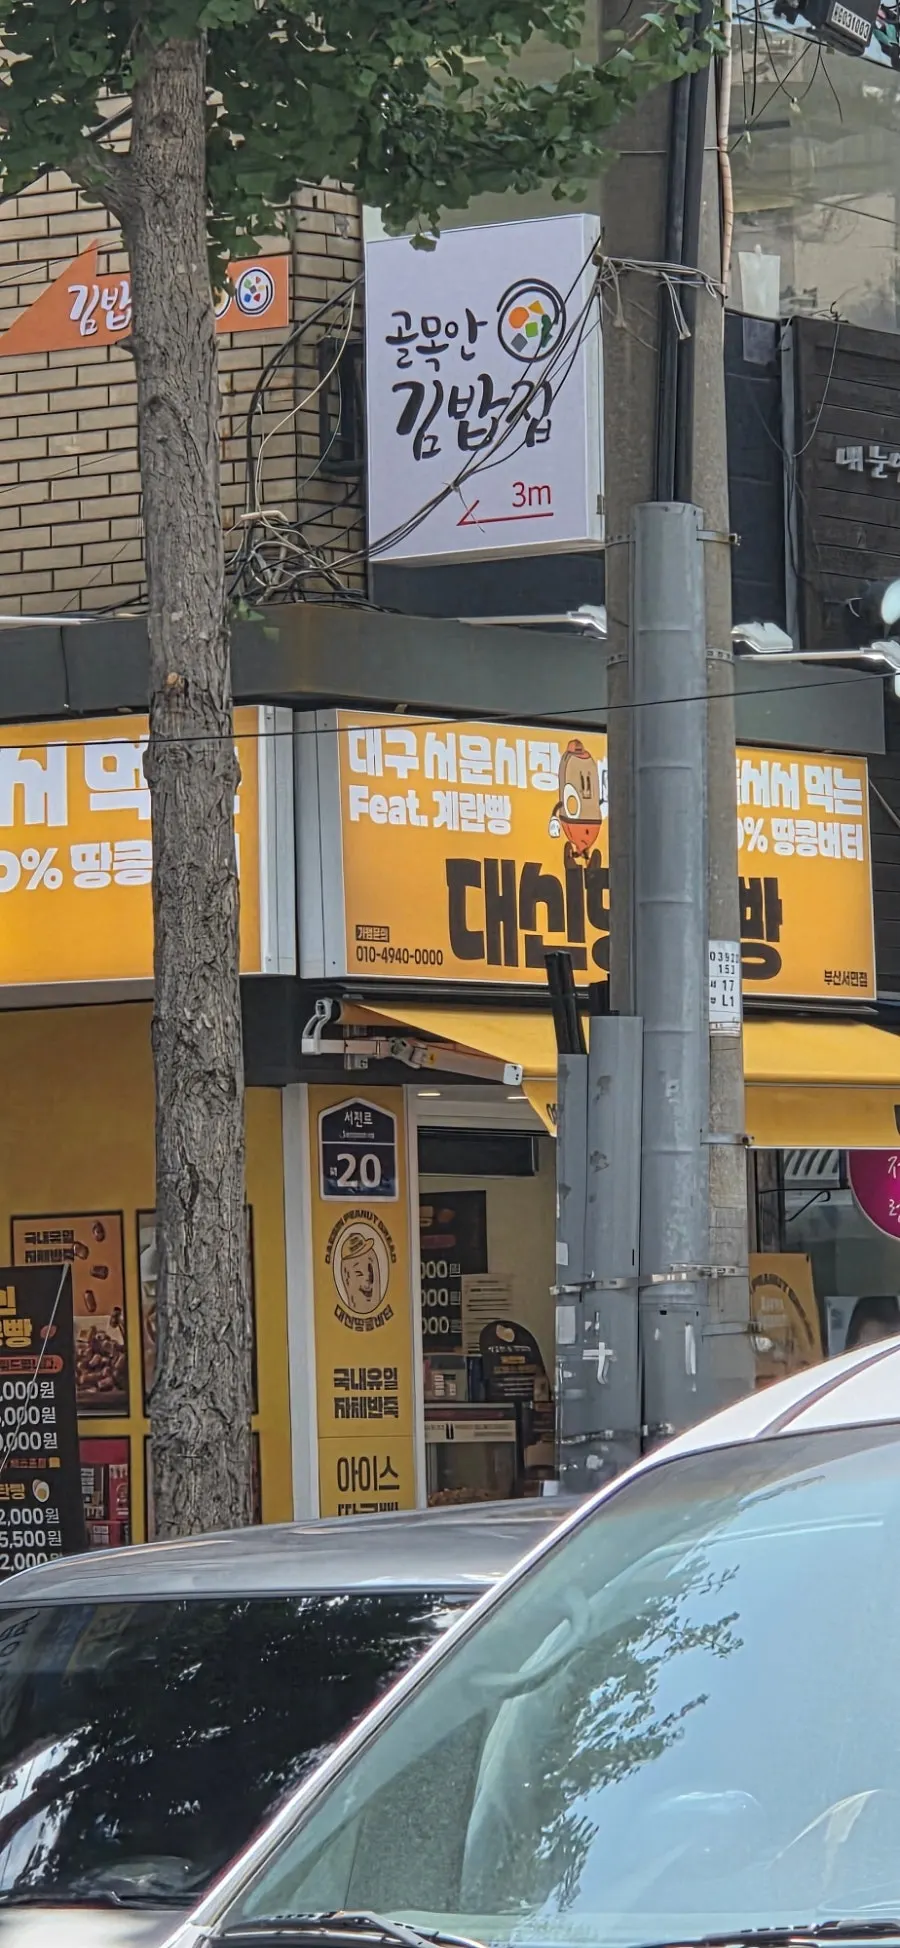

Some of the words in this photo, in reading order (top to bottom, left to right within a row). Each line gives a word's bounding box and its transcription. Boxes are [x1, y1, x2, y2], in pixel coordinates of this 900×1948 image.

[385, 308, 488, 372] 골목안
[391, 373, 553, 461] 김밥집
[512, 482, 552, 507] 3m
[348, 725, 419, 778] 대구
[424, 731, 560, 792] 서문시장
[804, 764, 862, 815] 먹는
[349, 785, 428, 827] Feat.
[432, 790, 512, 835] 계란빵
[771, 818, 863, 861] 땅콩버터
[356, 945, 443, 966] 010-4940-0000
[723, 980, 734, 991] 17
[824, 970, 868, 988] 부산서면점
[337, 1153, 382, 1188] 20
[334, 1367, 398, 1391] 국내유일
[334, 1396, 399, 1419] 자체반죽
[337, 1455, 400, 1492] 아이스
